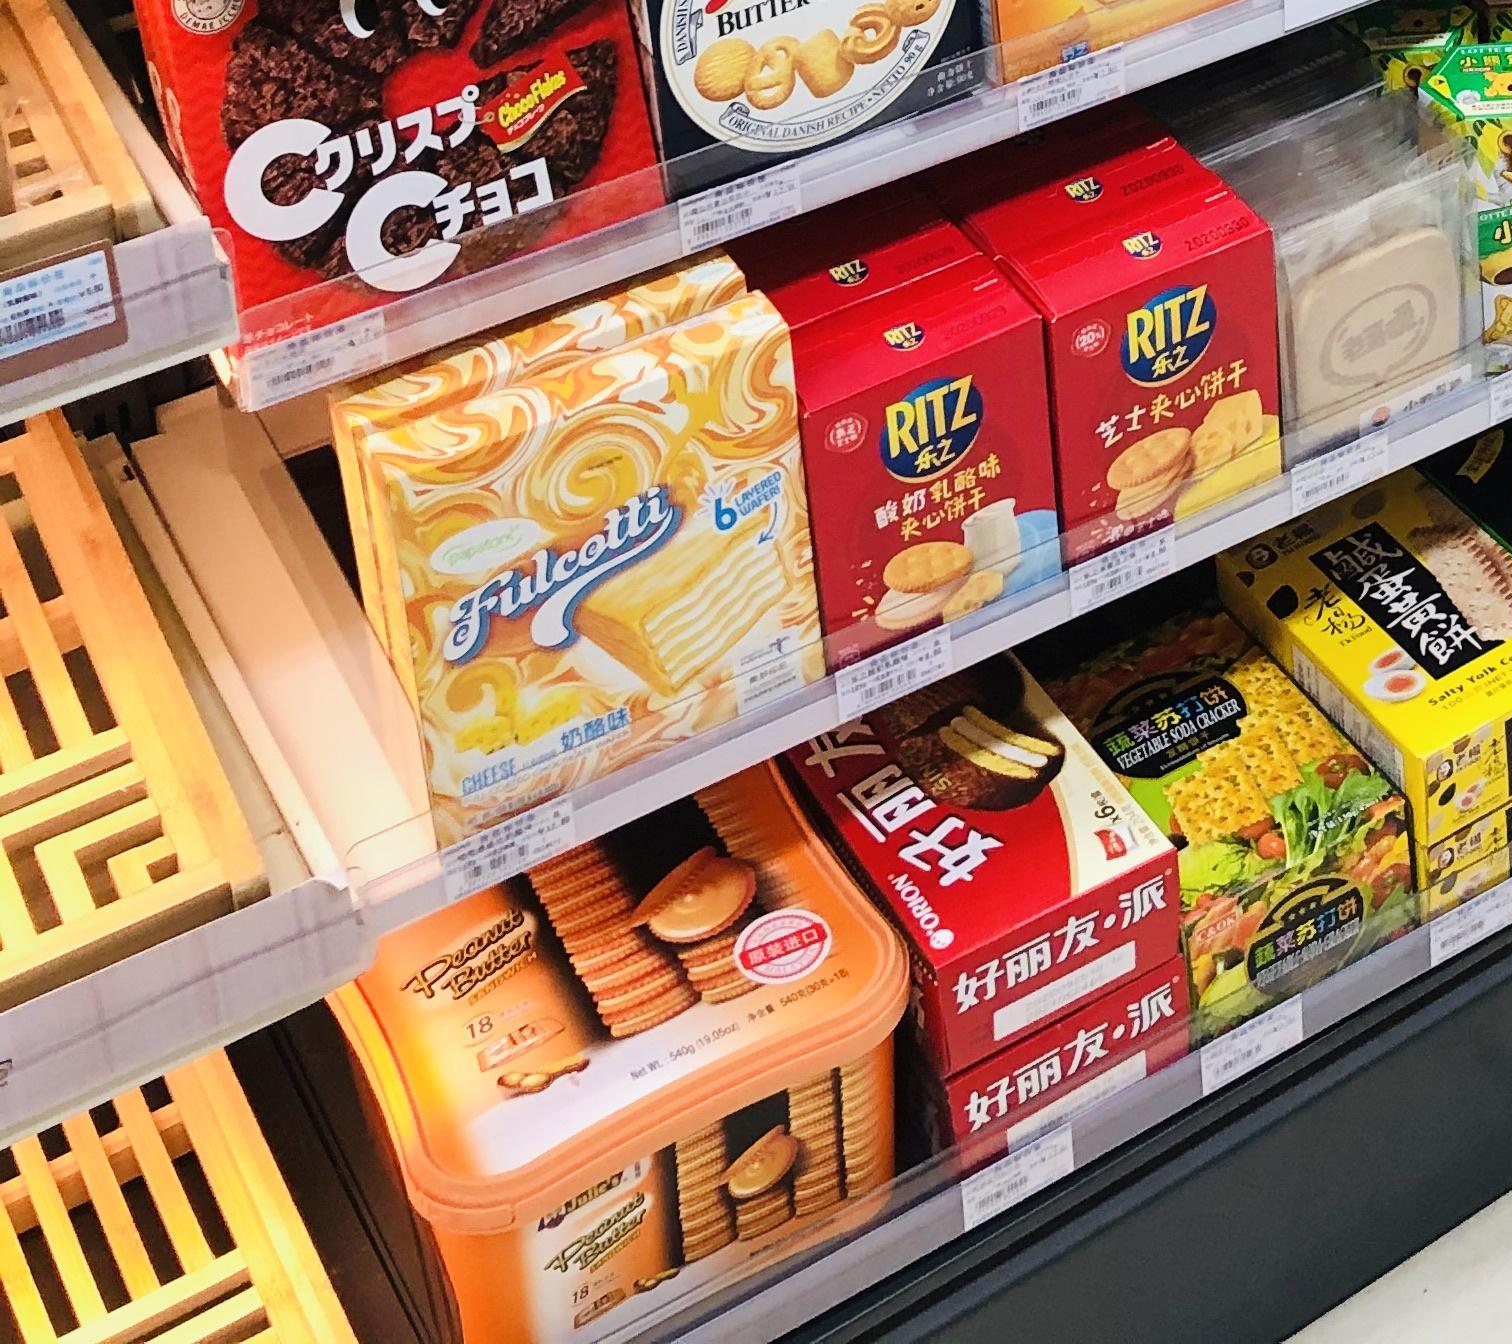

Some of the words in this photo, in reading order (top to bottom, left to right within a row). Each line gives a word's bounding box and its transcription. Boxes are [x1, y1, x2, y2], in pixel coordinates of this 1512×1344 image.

[1127, 284, 1211, 366] RITZ
[885, 376, 978, 454] RITZ
[1093, 358, 1250, 450] 芝士夹心饼干
[734, 472, 783, 509] LAYERED
[900, 489, 988, 541] 夹心饼干
[1103, 683, 1229, 757] 蔬菜苏打饼
[1116, 732, 1172, 771] VEGETABLE
[1171, 720, 1198, 744] SODA
[1196, 698, 1242, 732] CRACKER
[462, 758, 517, 797] CHEESE
[449, 930, 534, 1003] Butter
[745, 926, 821, 968] 原装进口
